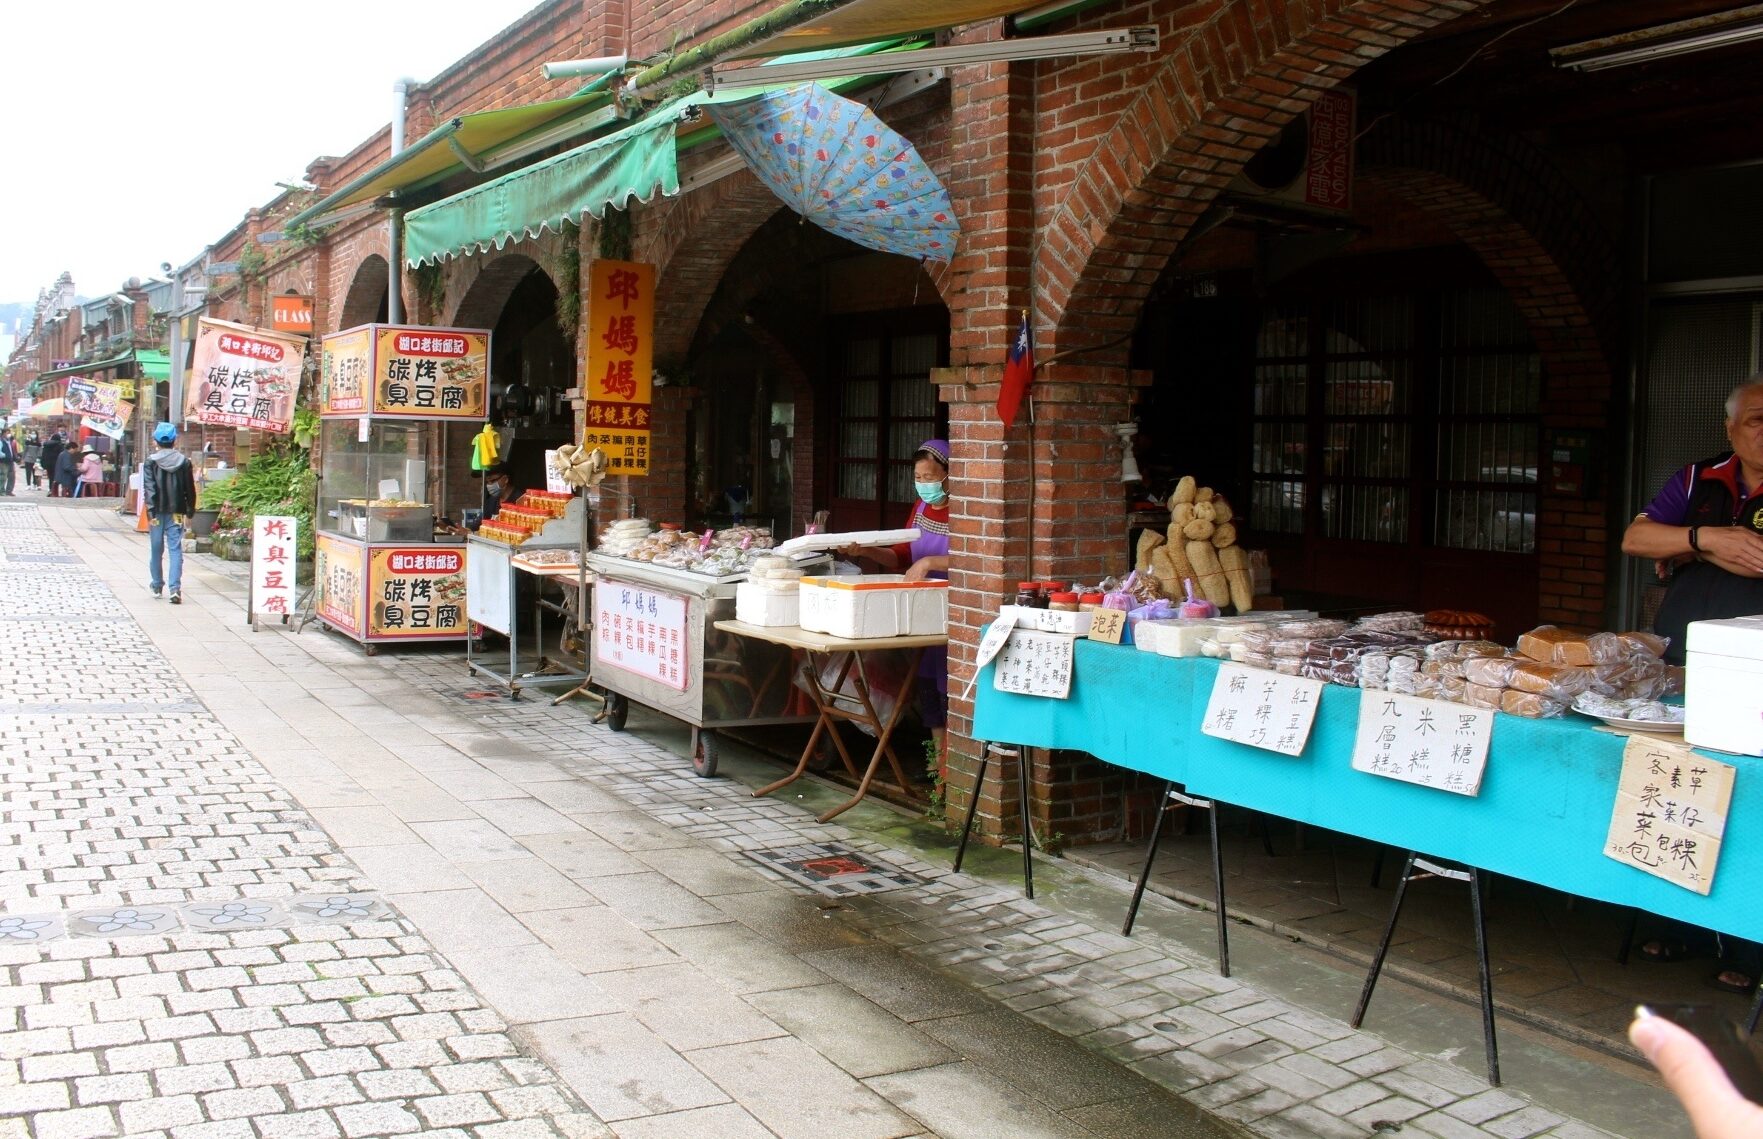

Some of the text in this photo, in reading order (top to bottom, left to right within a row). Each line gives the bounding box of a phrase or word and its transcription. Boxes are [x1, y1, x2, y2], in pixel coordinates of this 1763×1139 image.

[399, 336, 464, 354] 湖口老街邱記
[600, 268, 639, 401] 邱媽媽
[208, 365, 253, 391] 碳烤
[388, 359, 438, 383] 碳烤
[204, 388, 271, 421] 臭豆腐
[387, 383, 463, 410] 臭豆腐
[589, 405, 649, 427] 傳統美食
[262, 519, 289, 614] 炸臭豆腐
[392, 554, 458, 570] 湖口老街邱記
[384, 577, 432, 603] 碳烤
[622, 588, 658, 618] 邱媽媽
[383, 604, 458, 629] 臭豆腐
[625, 616, 634, 650] 菜包
[1092, 613, 1119, 639] 泡菜
[659, 626, 667, 679] 南瓜粿
[1249, 680, 1277, 745] 芋粿巧
[1277, 688, 1309, 750] 紅豆糕
[1370, 698, 1402, 773] 九層糕
[1407, 707, 1437, 773] 米糕
[1443, 714, 1477, 790] 黑糖糕
[1626, 751, 1670, 867] 客家菜包
[1656, 765, 1682, 851] 素菜包
[1670, 766, 1708, 871] 草仔粿
